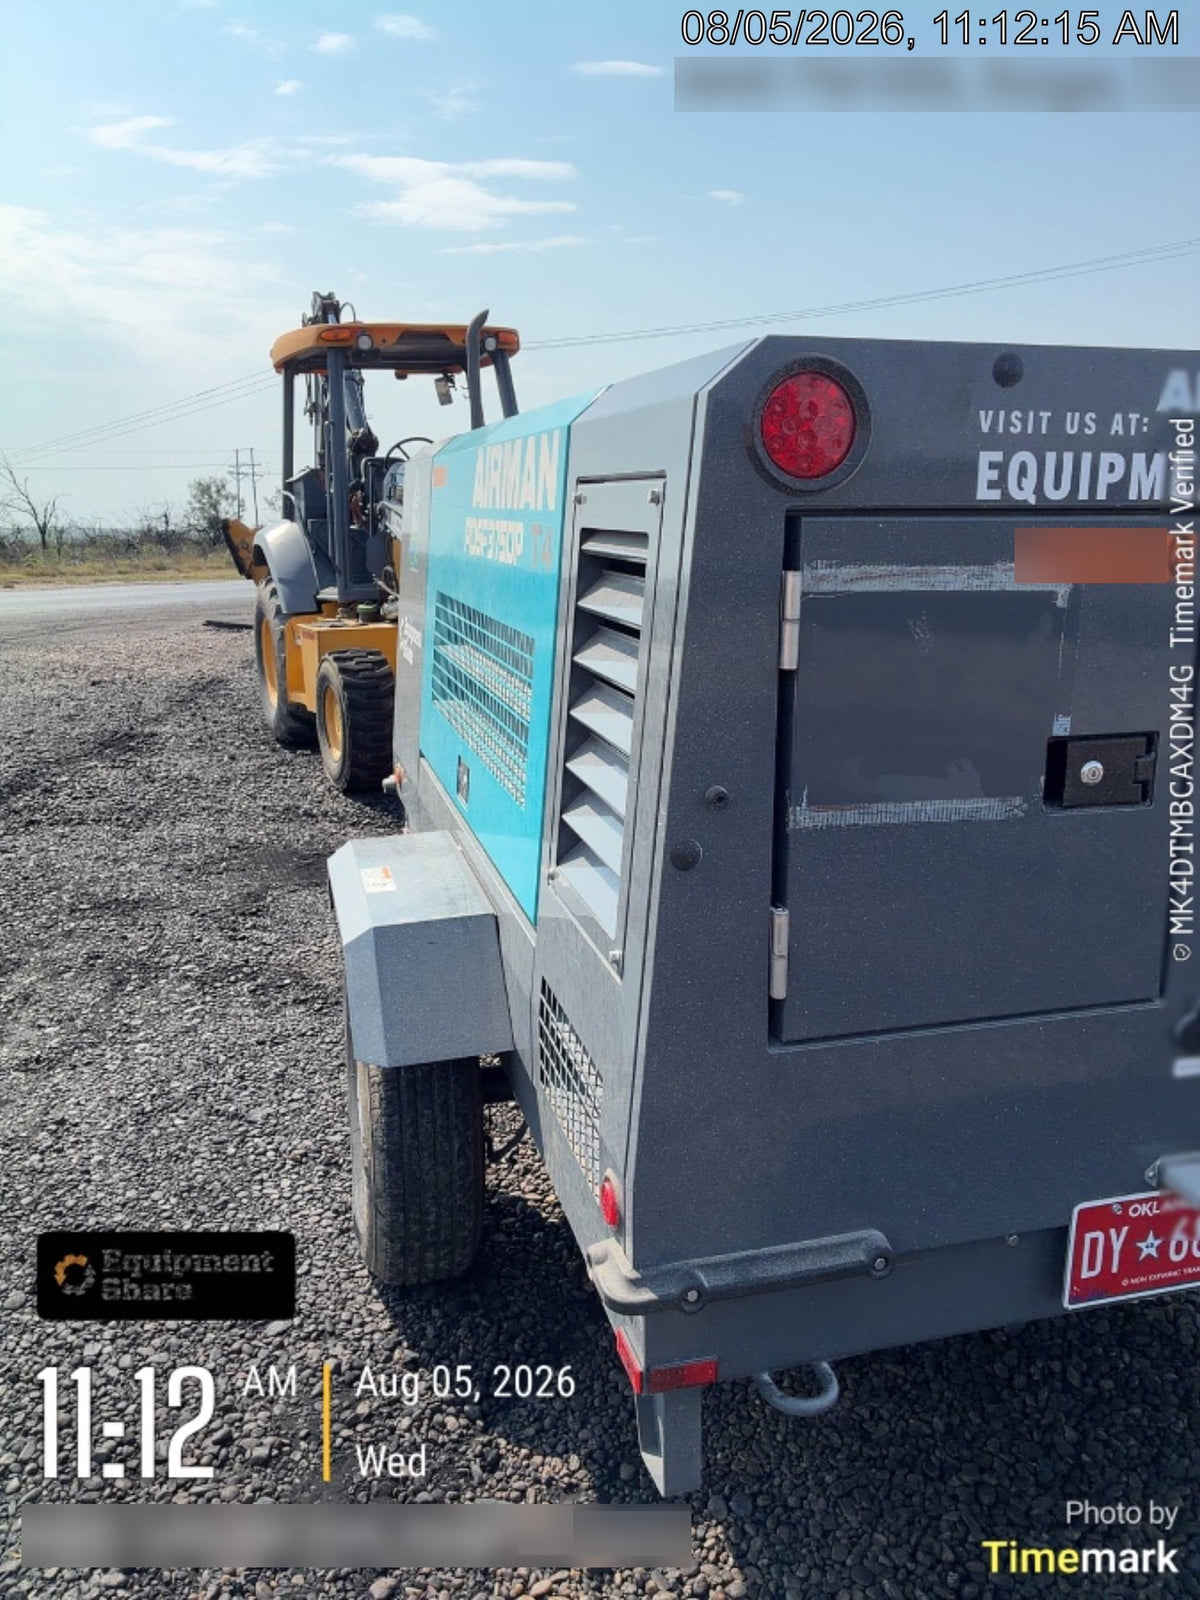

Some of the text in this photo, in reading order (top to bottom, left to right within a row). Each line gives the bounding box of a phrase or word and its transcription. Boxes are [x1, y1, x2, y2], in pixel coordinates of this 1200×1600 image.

[979, 409, 1149, 437] VISIT US AT:
[472, 429, 560, 511] AIRMAN
[976, 450, 1167, 505] EQUIPM
[1081, 1226, 1130, 1279] DY
